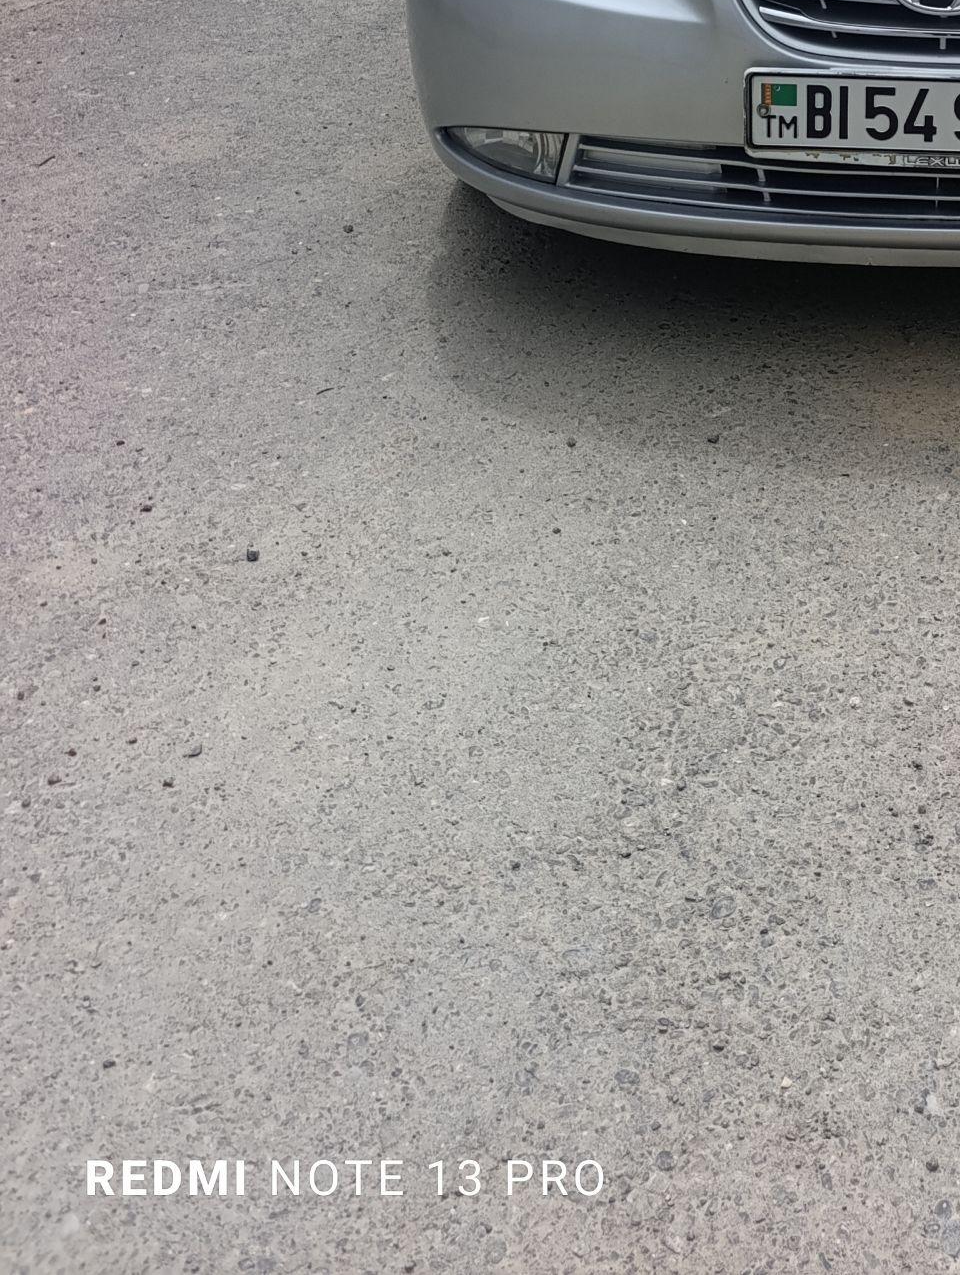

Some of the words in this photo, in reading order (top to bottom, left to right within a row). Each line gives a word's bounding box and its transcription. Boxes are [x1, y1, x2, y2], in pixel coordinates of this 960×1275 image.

[762, 115, 798, 139] TM
[806, 84, 849, 140] BI
[865, 86, 937, 143] 54
